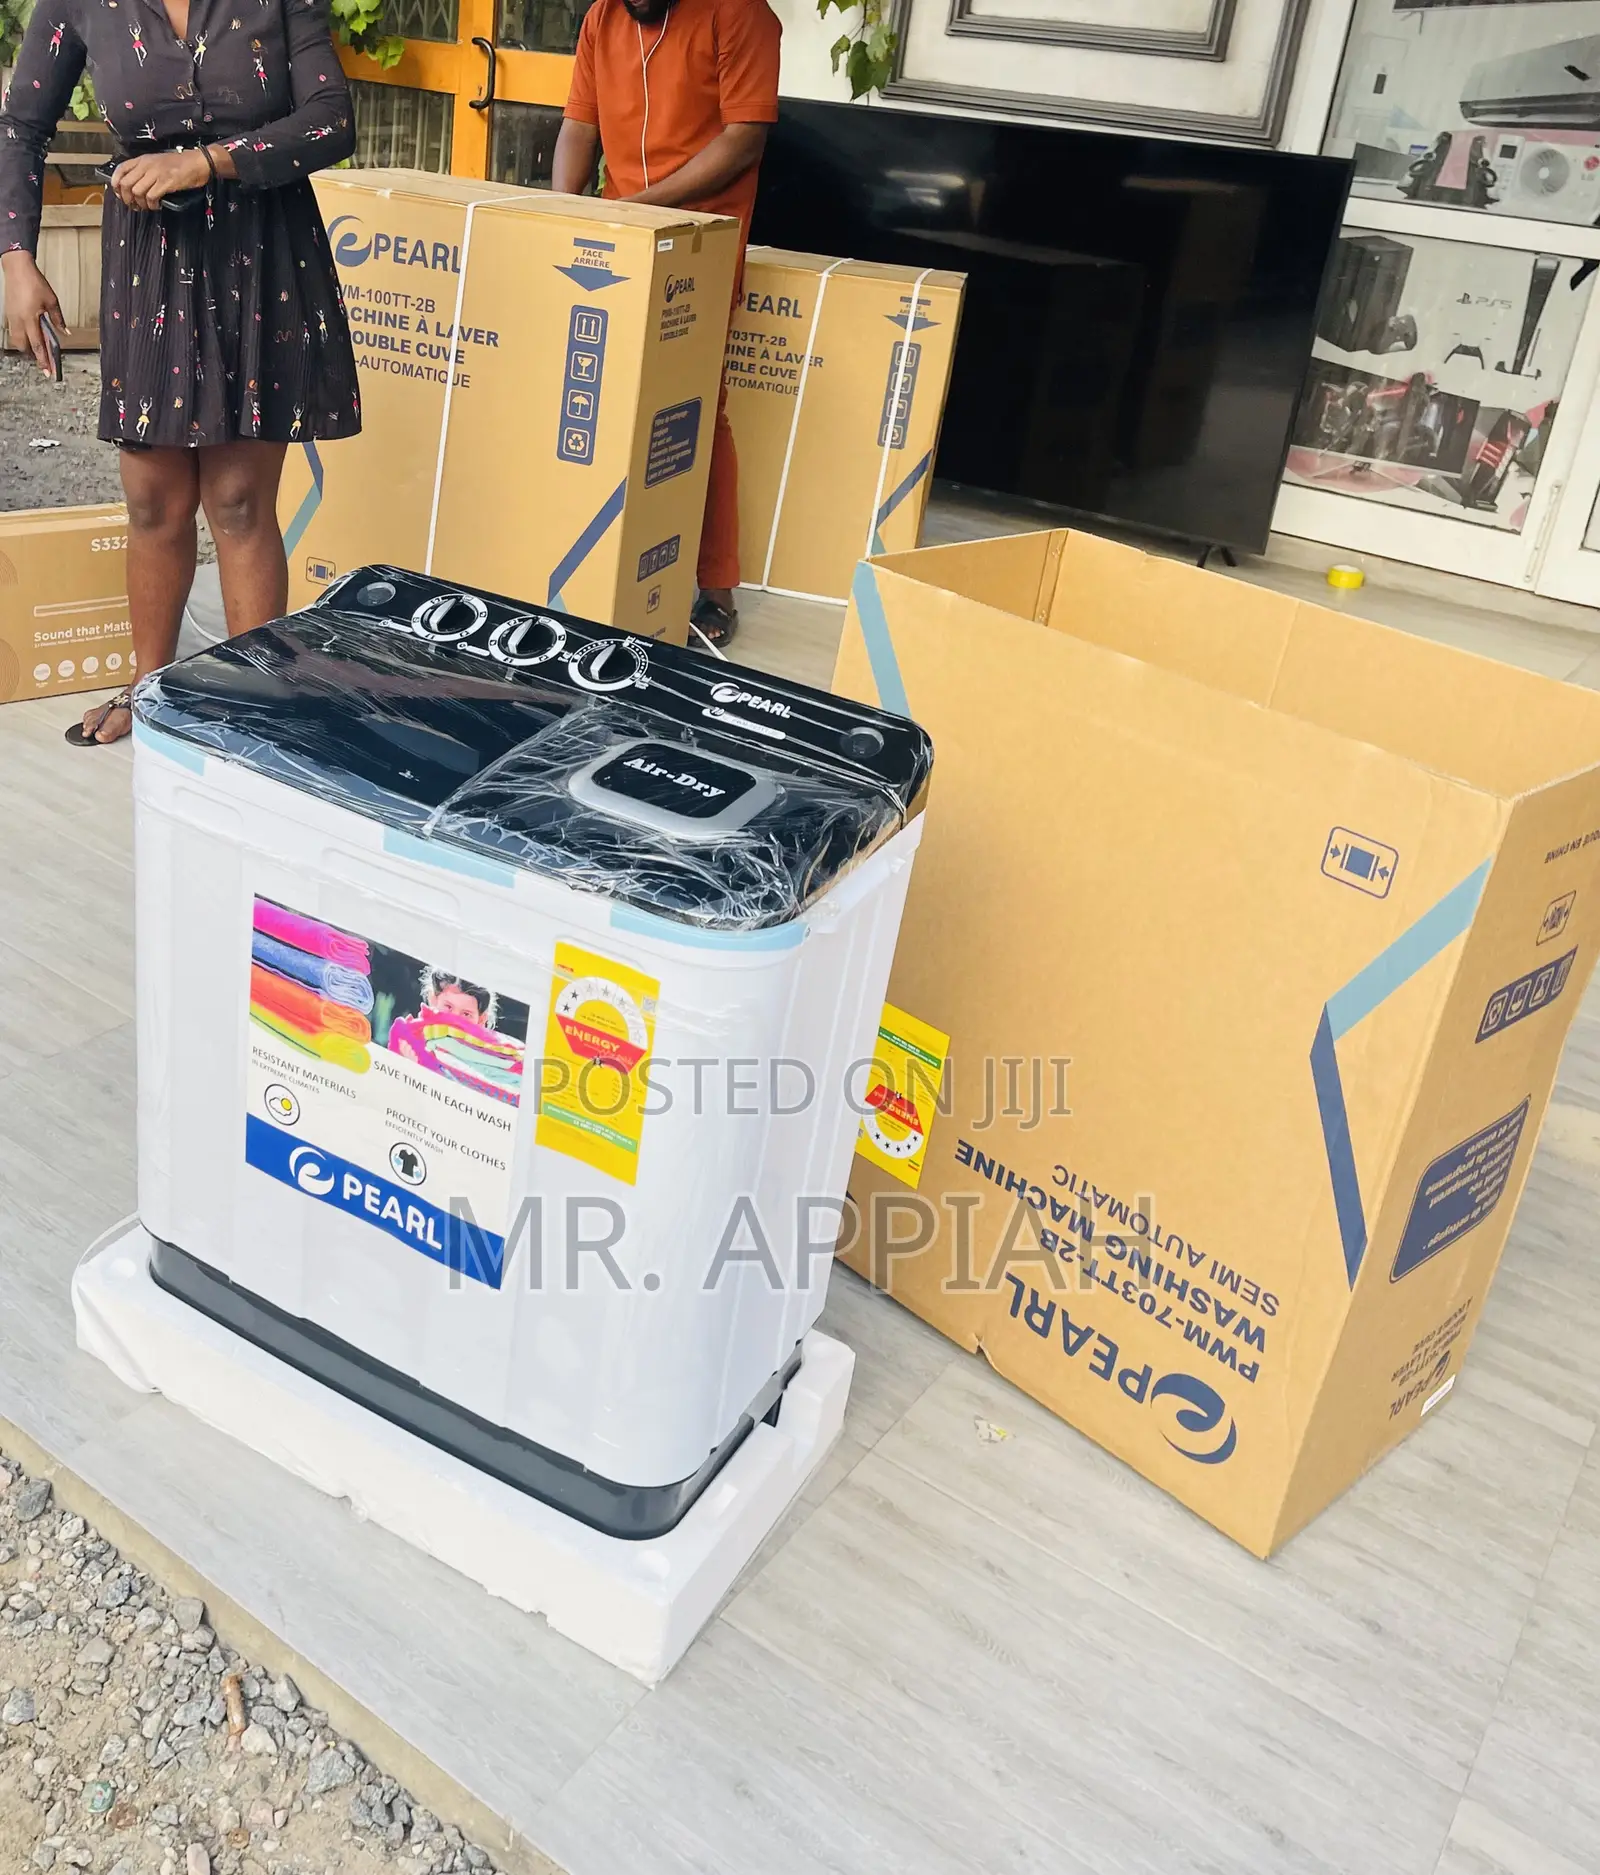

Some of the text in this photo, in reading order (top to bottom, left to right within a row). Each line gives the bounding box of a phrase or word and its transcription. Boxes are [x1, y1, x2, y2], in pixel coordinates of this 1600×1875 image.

[373, 232, 462, 274] PEARL
[582, 249, 603, 259] FACE
[341, 284, 436, 314] M-100TT-2B
[746, 292, 803, 319] EARL
[349, 306, 410, 331] CHINE
[415, 315, 429, 335] À
[351, 330, 465, 365] OUBLE CUVE
[355, 354, 471, 388] -AUTOMATIQUE
[760, 365, 797, 380] CUVE
[34, 628, 73, 642] Sound
[76, 625, 101, 637] that
[736, 691, 791, 719] PEARL
[623, 758, 726, 798] Air-Dry
[565, 1025, 621, 1053] ENERGY
[252, 1059, 259, 1067] IN
[252, 1046, 357, 1099] RESISTANT MATERIALS
[374, 1060, 512, 1131] SAVE TIME IN EACH WASH
[386, 1107, 506, 1171] PROTECT YOUR CLOTHES
[424, 1139, 444, 1155] WASH
[342, 1172, 443, 1250] PEARL
[954, 1137, 1266, 1353] WASHING MACHINE
[1051, 1163, 1281, 1318] SEMI AUTOMATIC
[1040, 1226, 1261, 1384] PWM-703TT-2B
[1005, 1271, 1154, 1405] PEARL
